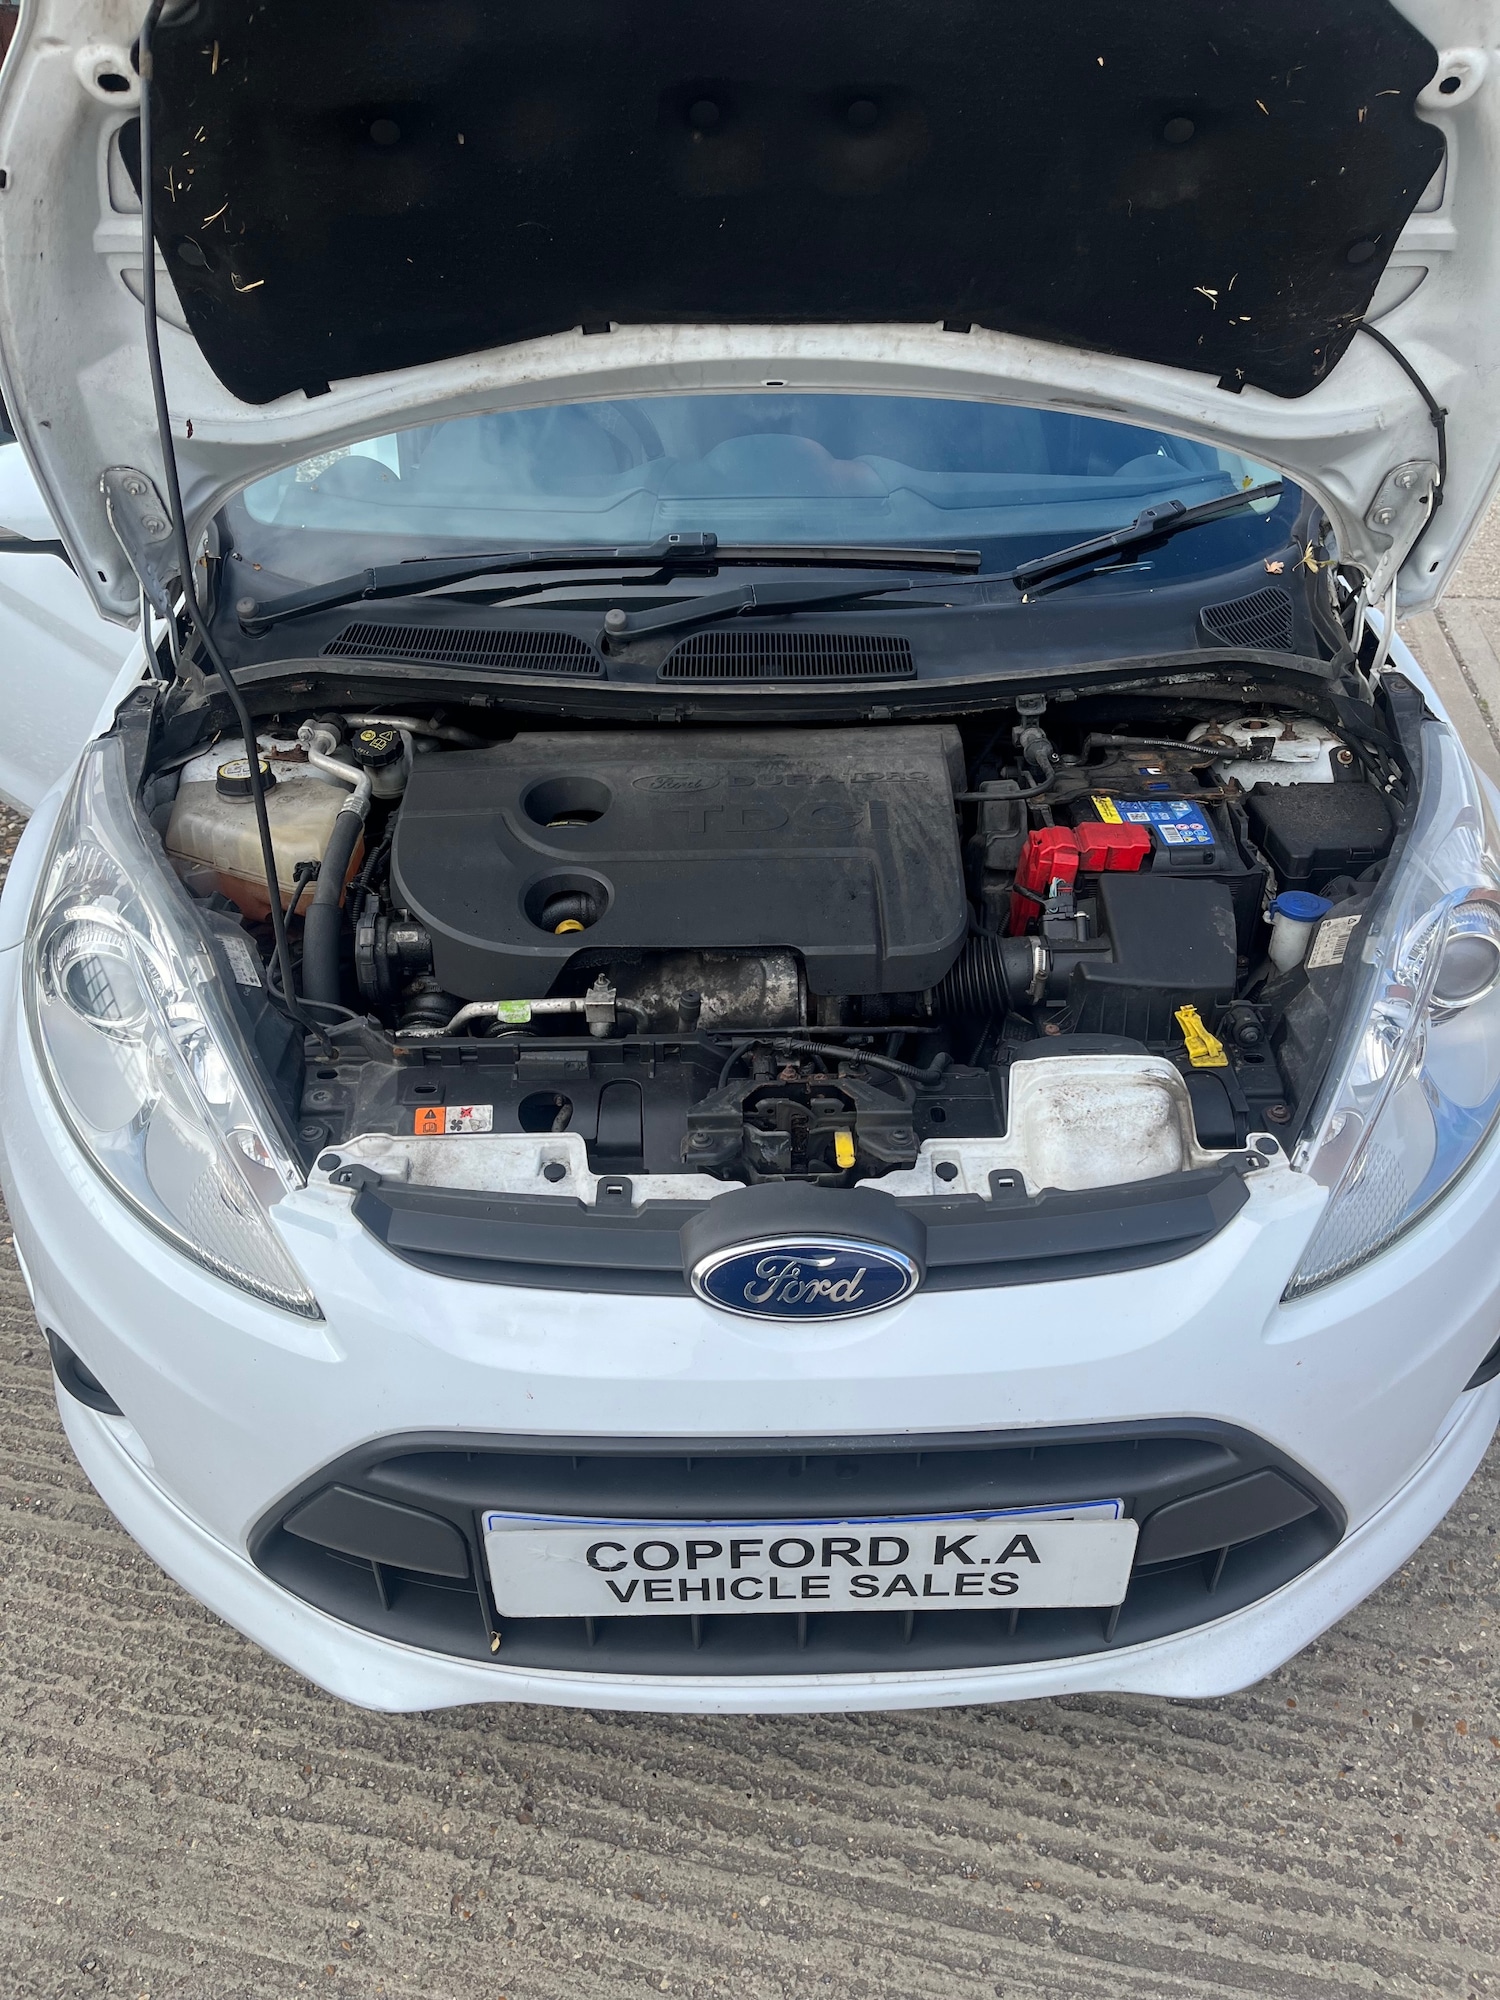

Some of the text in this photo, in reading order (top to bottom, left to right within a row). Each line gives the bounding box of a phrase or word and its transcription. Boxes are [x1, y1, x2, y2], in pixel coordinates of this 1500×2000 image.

[649, 775, 703, 792] Ford
[743, 1255, 867, 1303] Ford
[586, 1533, 1042, 1572] COPFORD K.A
[604, 1571, 1021, 1603] VEHICLE SALES
